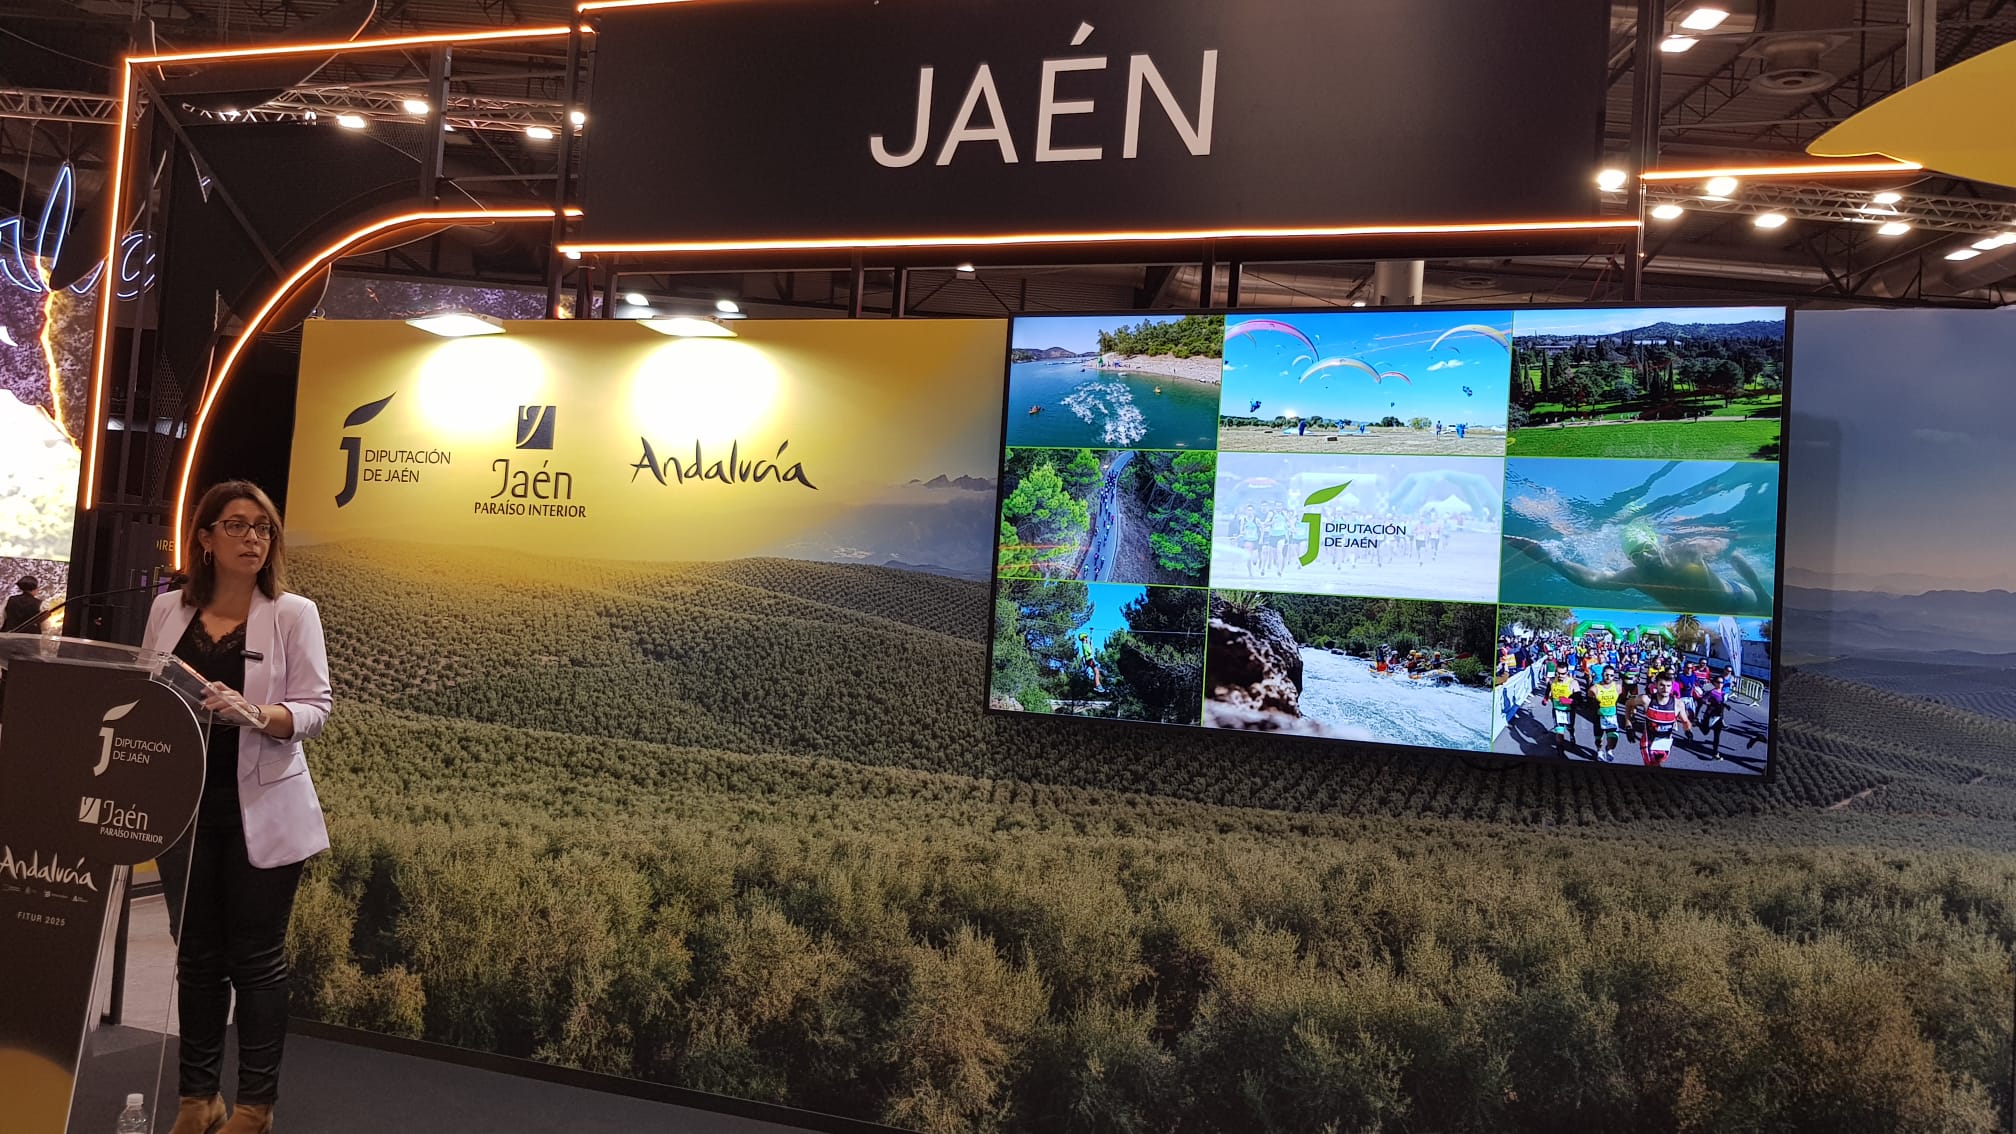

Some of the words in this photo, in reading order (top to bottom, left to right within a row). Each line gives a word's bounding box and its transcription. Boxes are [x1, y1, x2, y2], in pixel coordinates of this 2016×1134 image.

[869, 21, 1218, 168] JAÉN
[364, 448, 452, 465] DIPUTACIÓN
[630, 436, 819, 491] Andalucía
[363, 468, 383, 482] DE
[384, 467, 420, 483] JAÉN
[490, 458, 573, 500] Jaén
[474, 499, 526, 516] PARAÍSO
[528, 503, 587, 518] INTERIOR
[1325, 522, 1407, 535] DIPUTACIÓN
[1324, 537, 1343, 547] DE
[1344, 536, 1378, 549] JAÉN
[114, 737, 172, 754] DIPUTACIÓN
[112, 750, 125, 761] DE
[127, 751, 150, 764] JAÉN
[101, 800, 148, 831] Jaén
[100, 827, 129, 839] PARAÍSO
[130, 831, 163, 845] INTERIOR
[0, 844, 99, 892] Andalucía
[17, 911, 42, 923] FITUR
[44, 915, 66, 927] 2025
